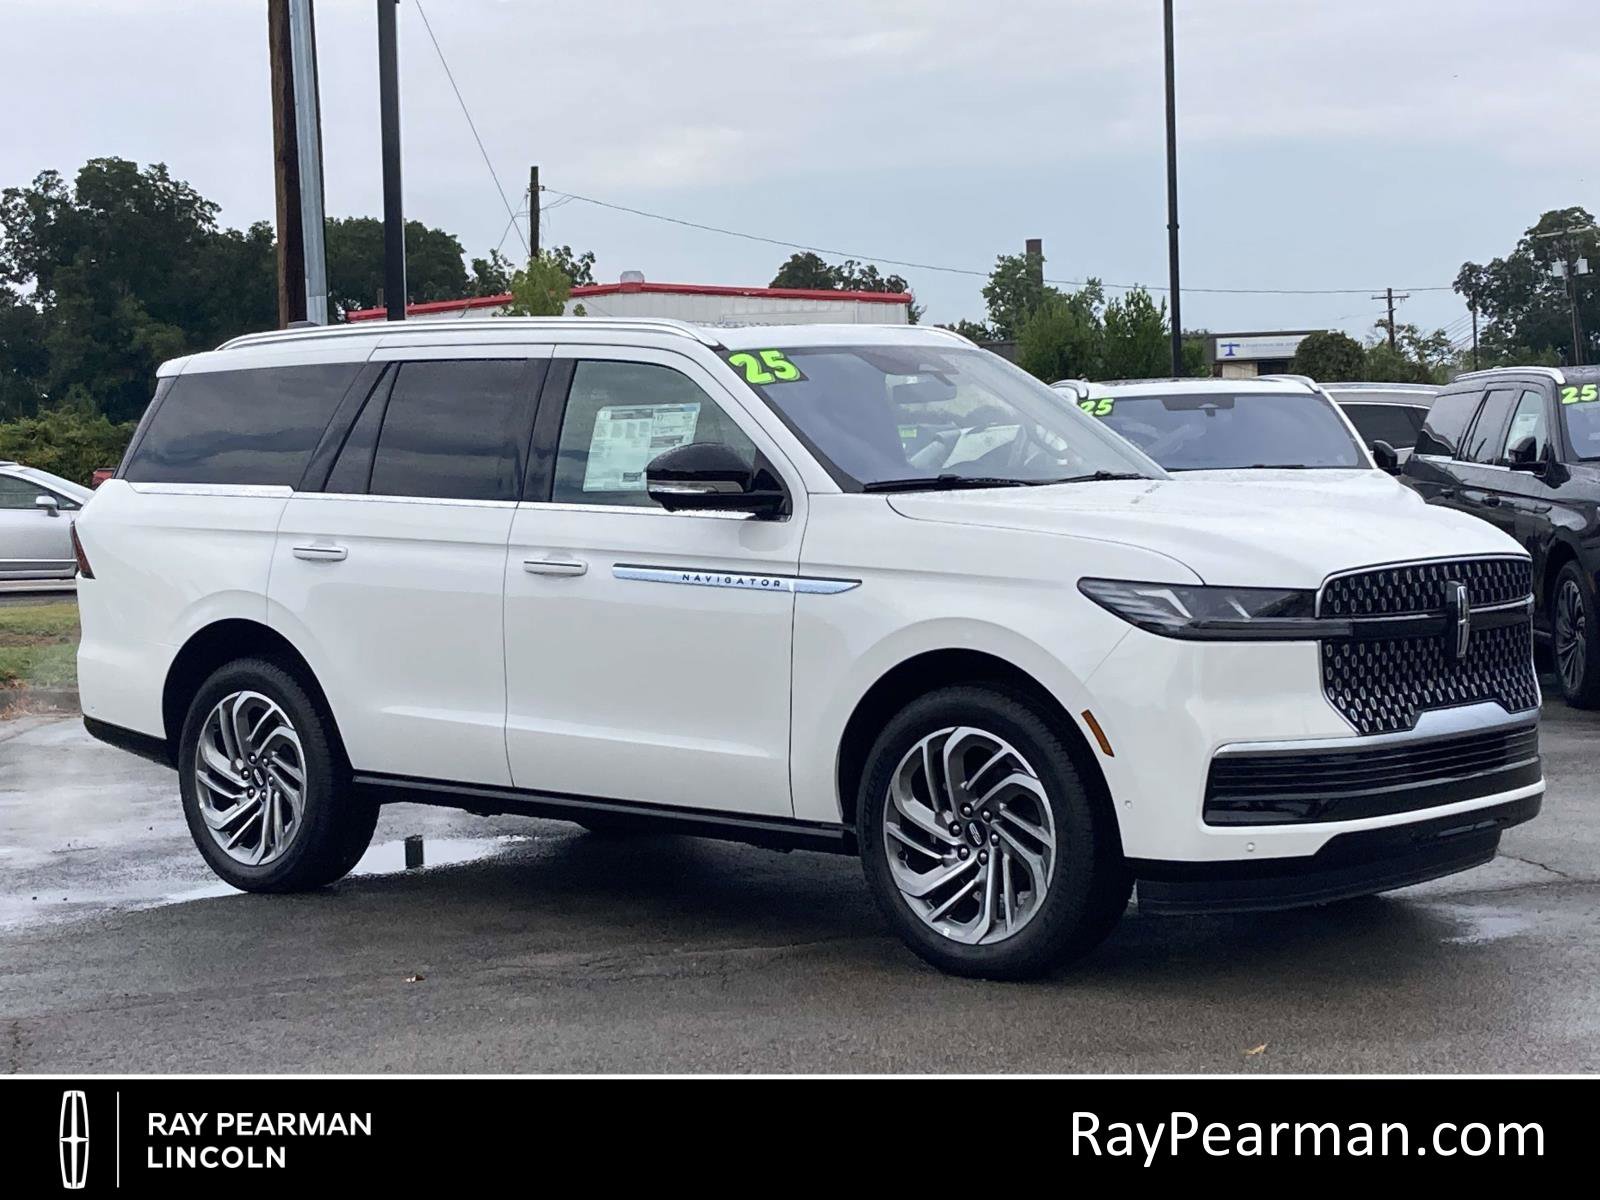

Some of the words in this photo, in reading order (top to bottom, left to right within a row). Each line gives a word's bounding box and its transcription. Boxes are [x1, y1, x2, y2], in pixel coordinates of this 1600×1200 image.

[728, 350, 800, 384] 25
[1561, 384, 1598, 404] 25
[1080, 398, 1114, 415] 25
[682, 574, 781, 587] NAVIGATOR
